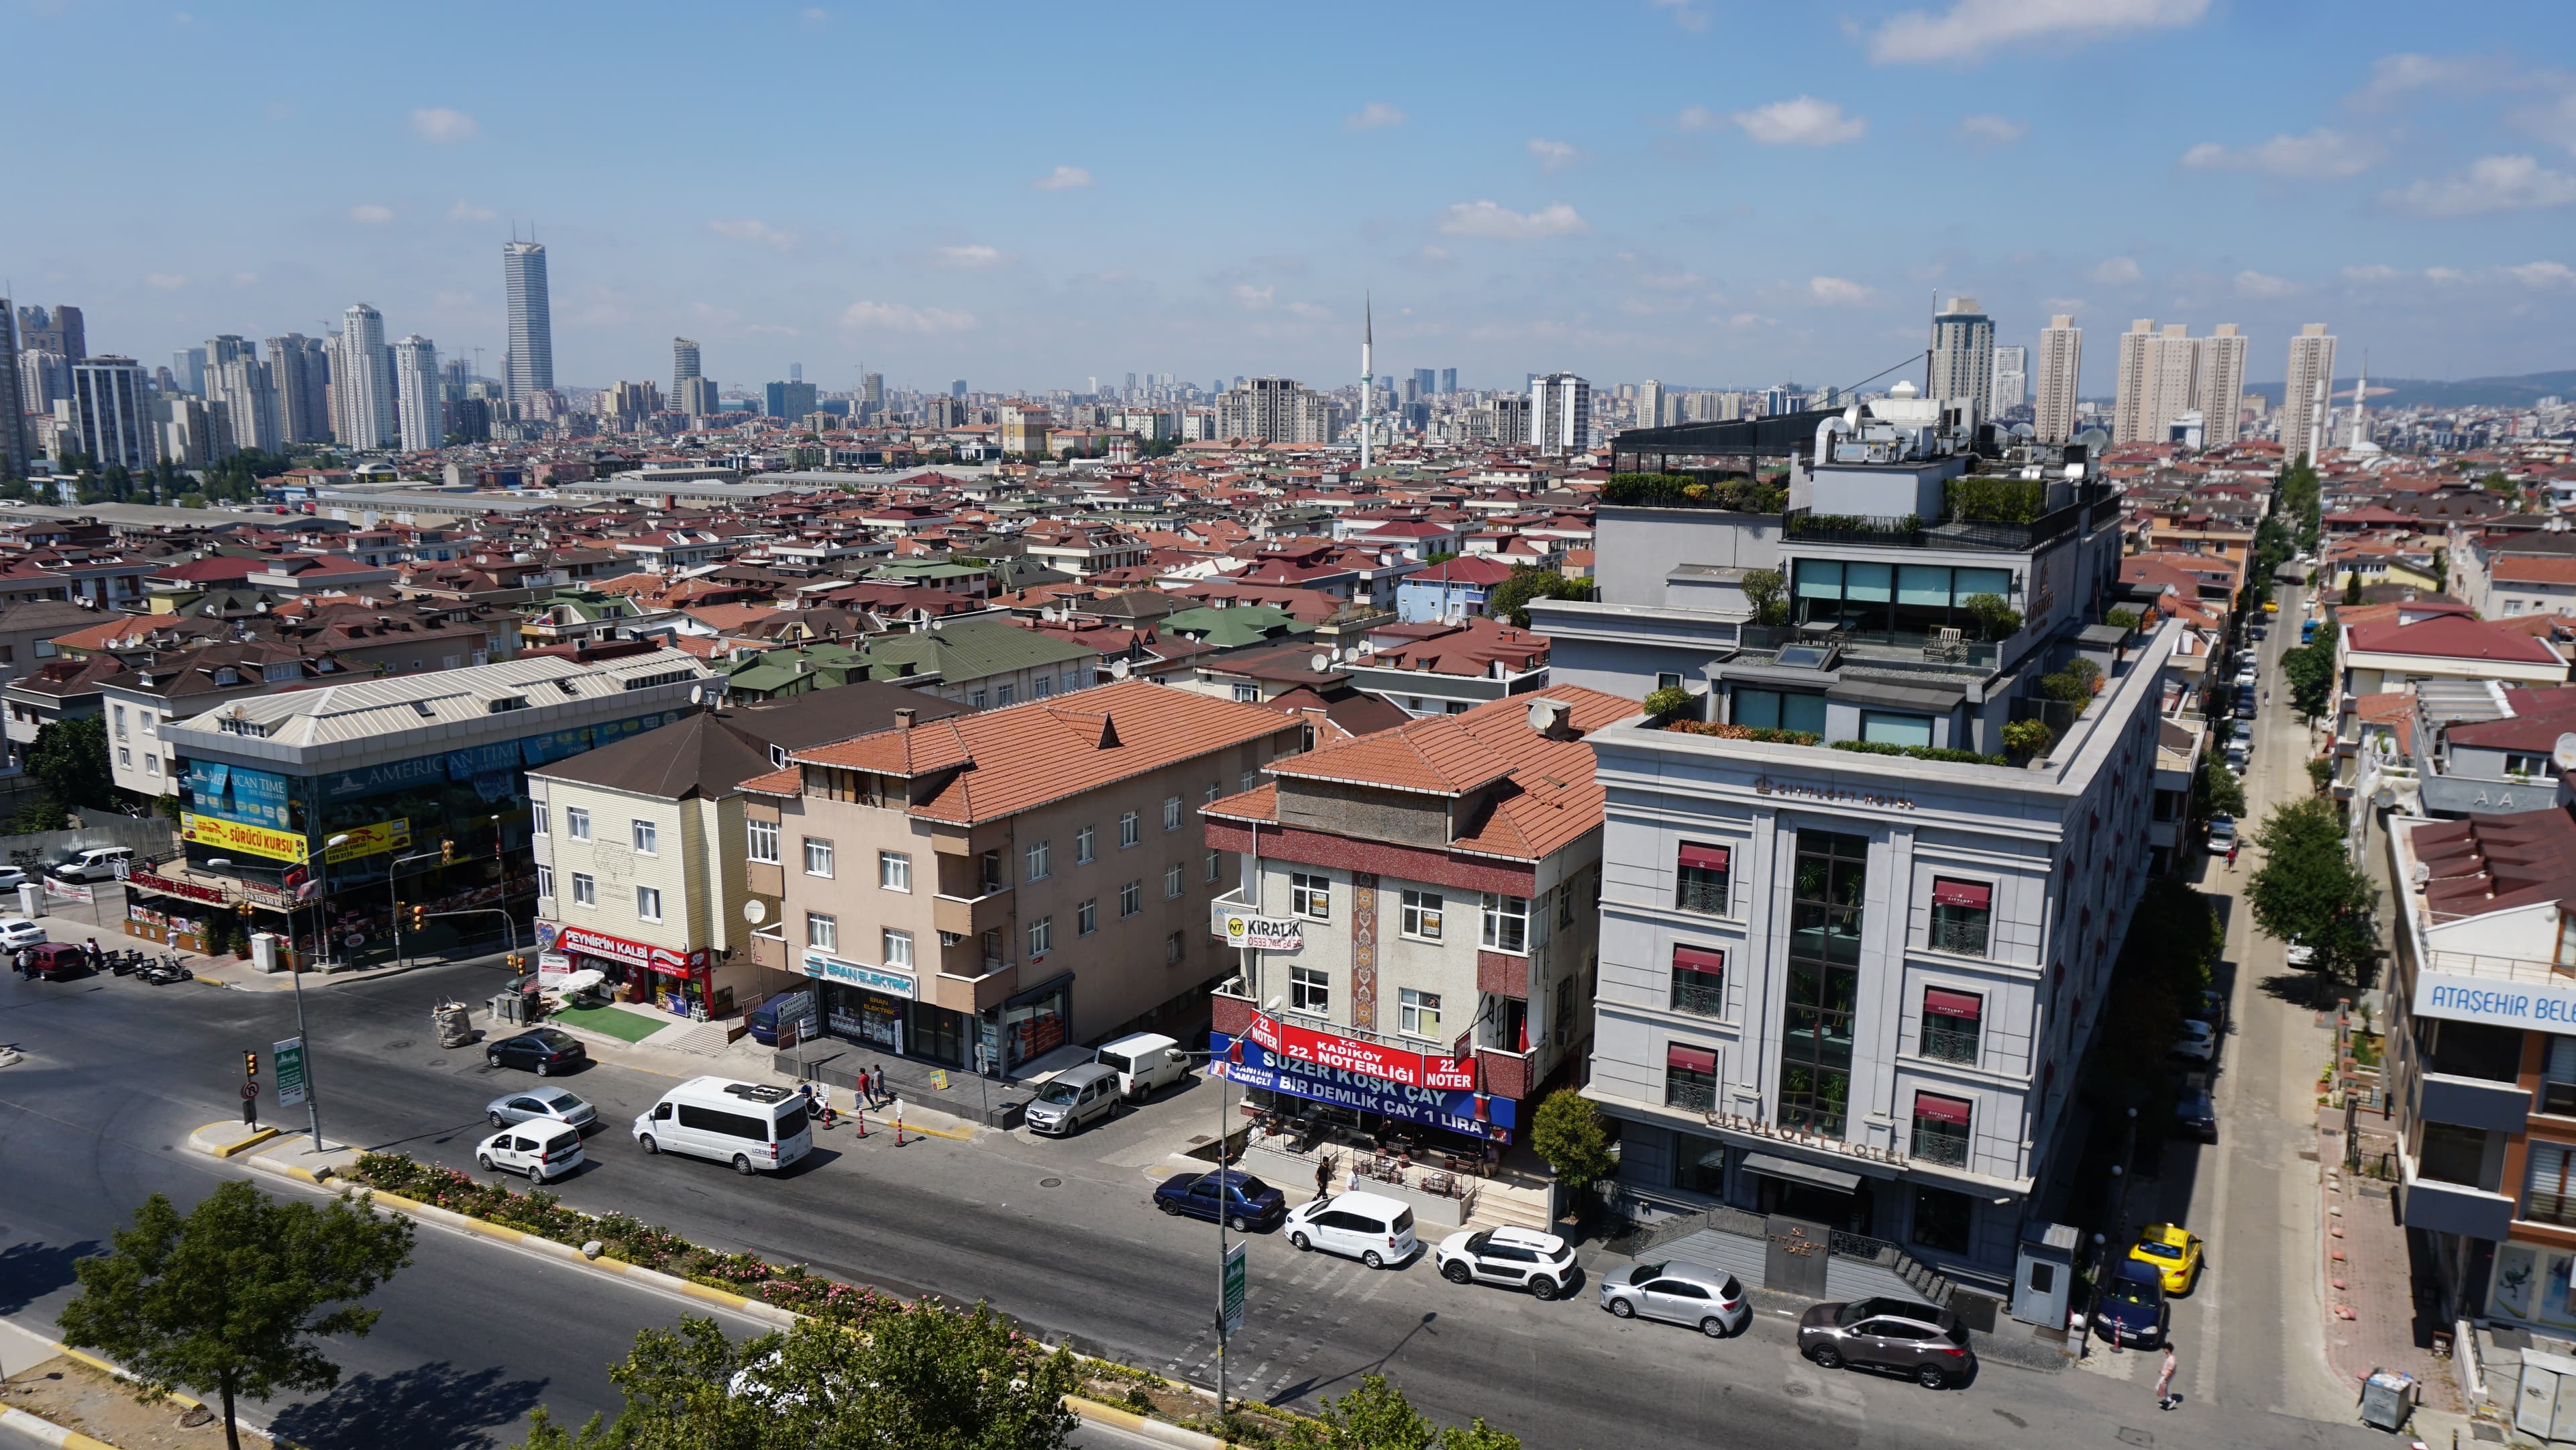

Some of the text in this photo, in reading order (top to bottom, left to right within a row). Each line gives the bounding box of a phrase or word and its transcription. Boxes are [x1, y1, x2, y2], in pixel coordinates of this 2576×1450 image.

[368, 747, 473, 784] AMERICAN
[209, 770, 284, 794] AMERICAN TIME
[1779, 783, 1916, 811] CITYLOFT HOTEL
[229, 827, 262, 847] SÜRÜCÜ
[264, 835, 292, 853] KURSU
[1947, 896, 1974, 904] CITYLOFT
[375, 921, 431, 940] KÜNEE
[1230, 923, 1242, 931] NT
[616, 941, 648, 960] KALBİ
[1248, 937, 1267, 947] 0533
[1268, 938, 1281, 948] 744
[826, 962, 857, 980] ERAN
[858, 970, 912, 993] ELEKTRİK
[869, 996, 889, 1006] ERAN
[1937, 1006, 1964, 1014] CITYLOFT
[2431, 986, 2529, 1017] ATAŞEHİR
[1259, 1017, 1271, 1032] 22.
[1252, 1027, 1278, 1051] NOTER
[1339, 1039, 1360, 1049] T.C.
[1317, 1041, 1383, 1063] KADIKÖY
[1455, 1043, 1471, 1062] NOTER
[1235, 1064, 1273, 1079] TANITIM
[1288, 1045, 1414, 1083] 22. NOTERLİĞİ
[1440, 1059, 1459, 1072] 22.
[1234, 1074, 1271, 1086] AMAÇLI
[1426, 1074, 1471, 1088] NOTER
[1279, 1075, 1483, 1135] BİR DEMLİK ÇAY 1 LİRA
[1404, 1085, 1448, 1107] ÇAY
[1928, 1110, 1953, 1119] CITYLOFT
[1705, 1109, 1909, 1166] CITYLOFT HOTEL
[752, 1148, 770, 1156] LCE182
[1770, 1234, 1826, 1253] CITYLOFT
[1782, 1243, 1811, 1257] HOTEL
